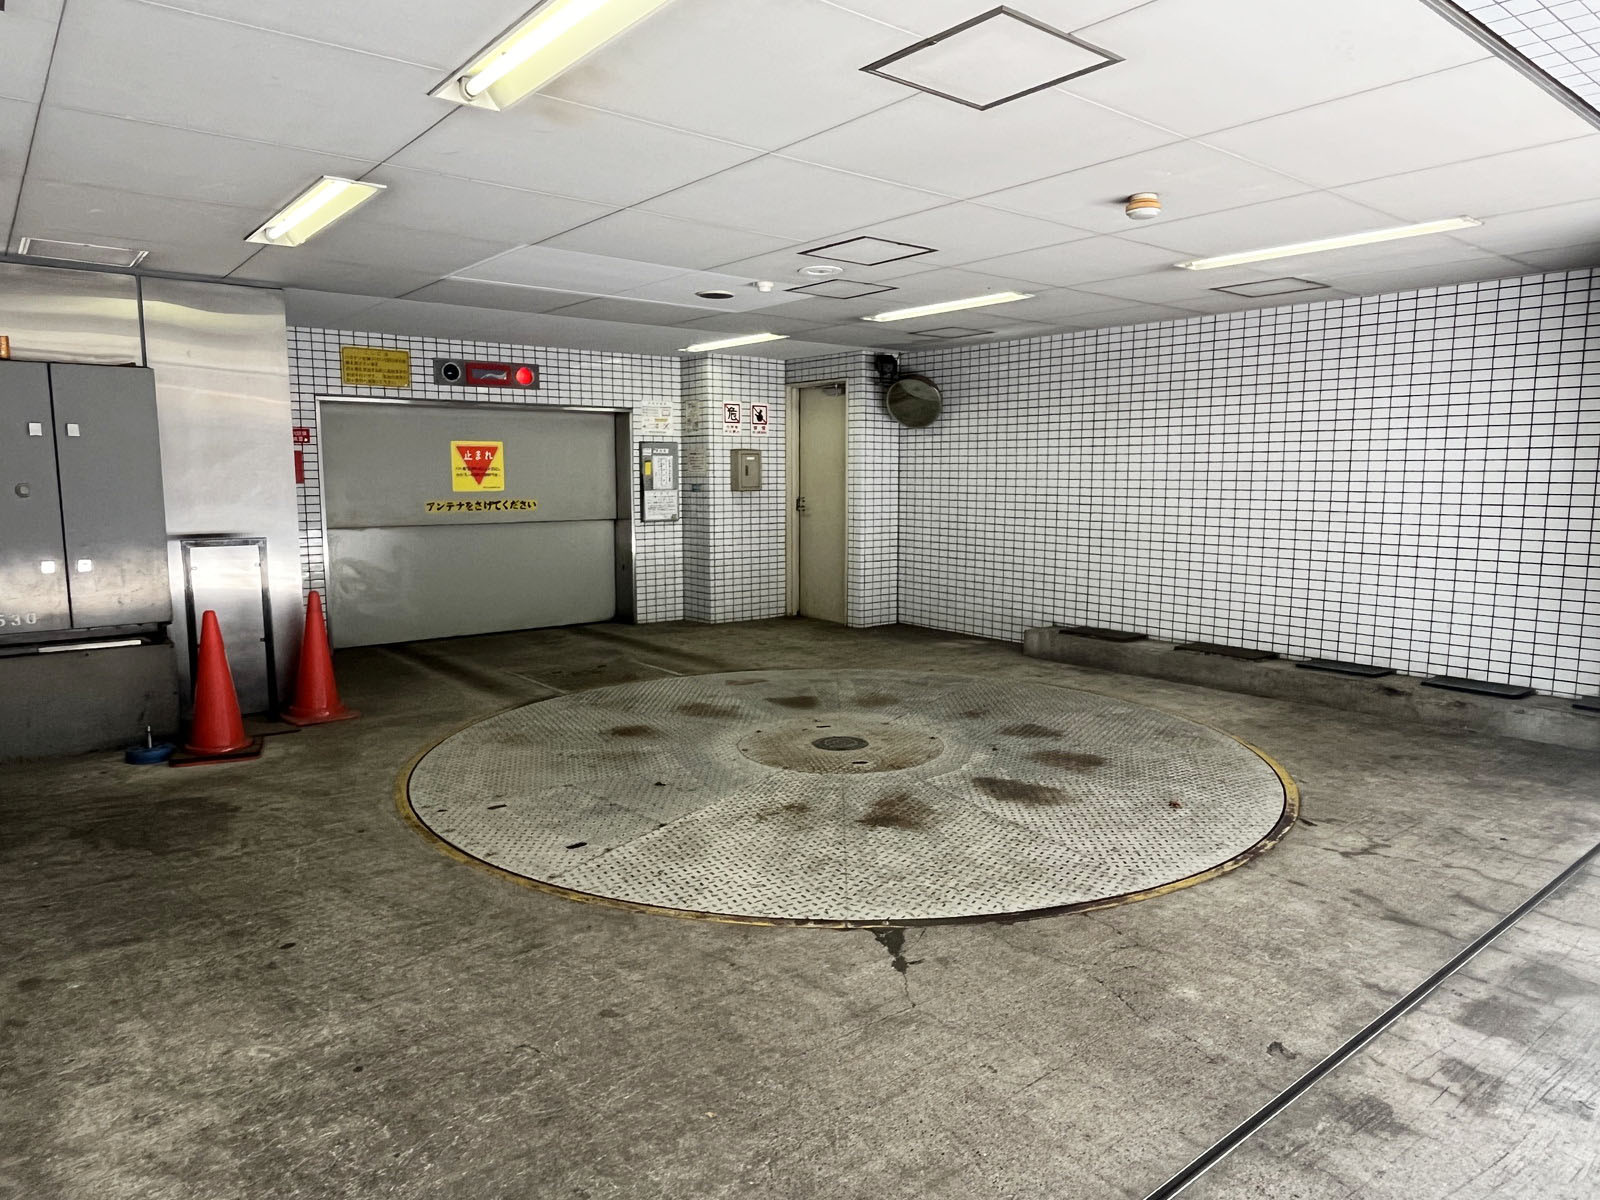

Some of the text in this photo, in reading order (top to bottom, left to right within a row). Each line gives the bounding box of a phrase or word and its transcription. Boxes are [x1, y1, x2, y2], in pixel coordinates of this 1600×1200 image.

[464, 450, 494, 461] 止まれ
[426, 500, 537, 512] アンテナをさげてください
